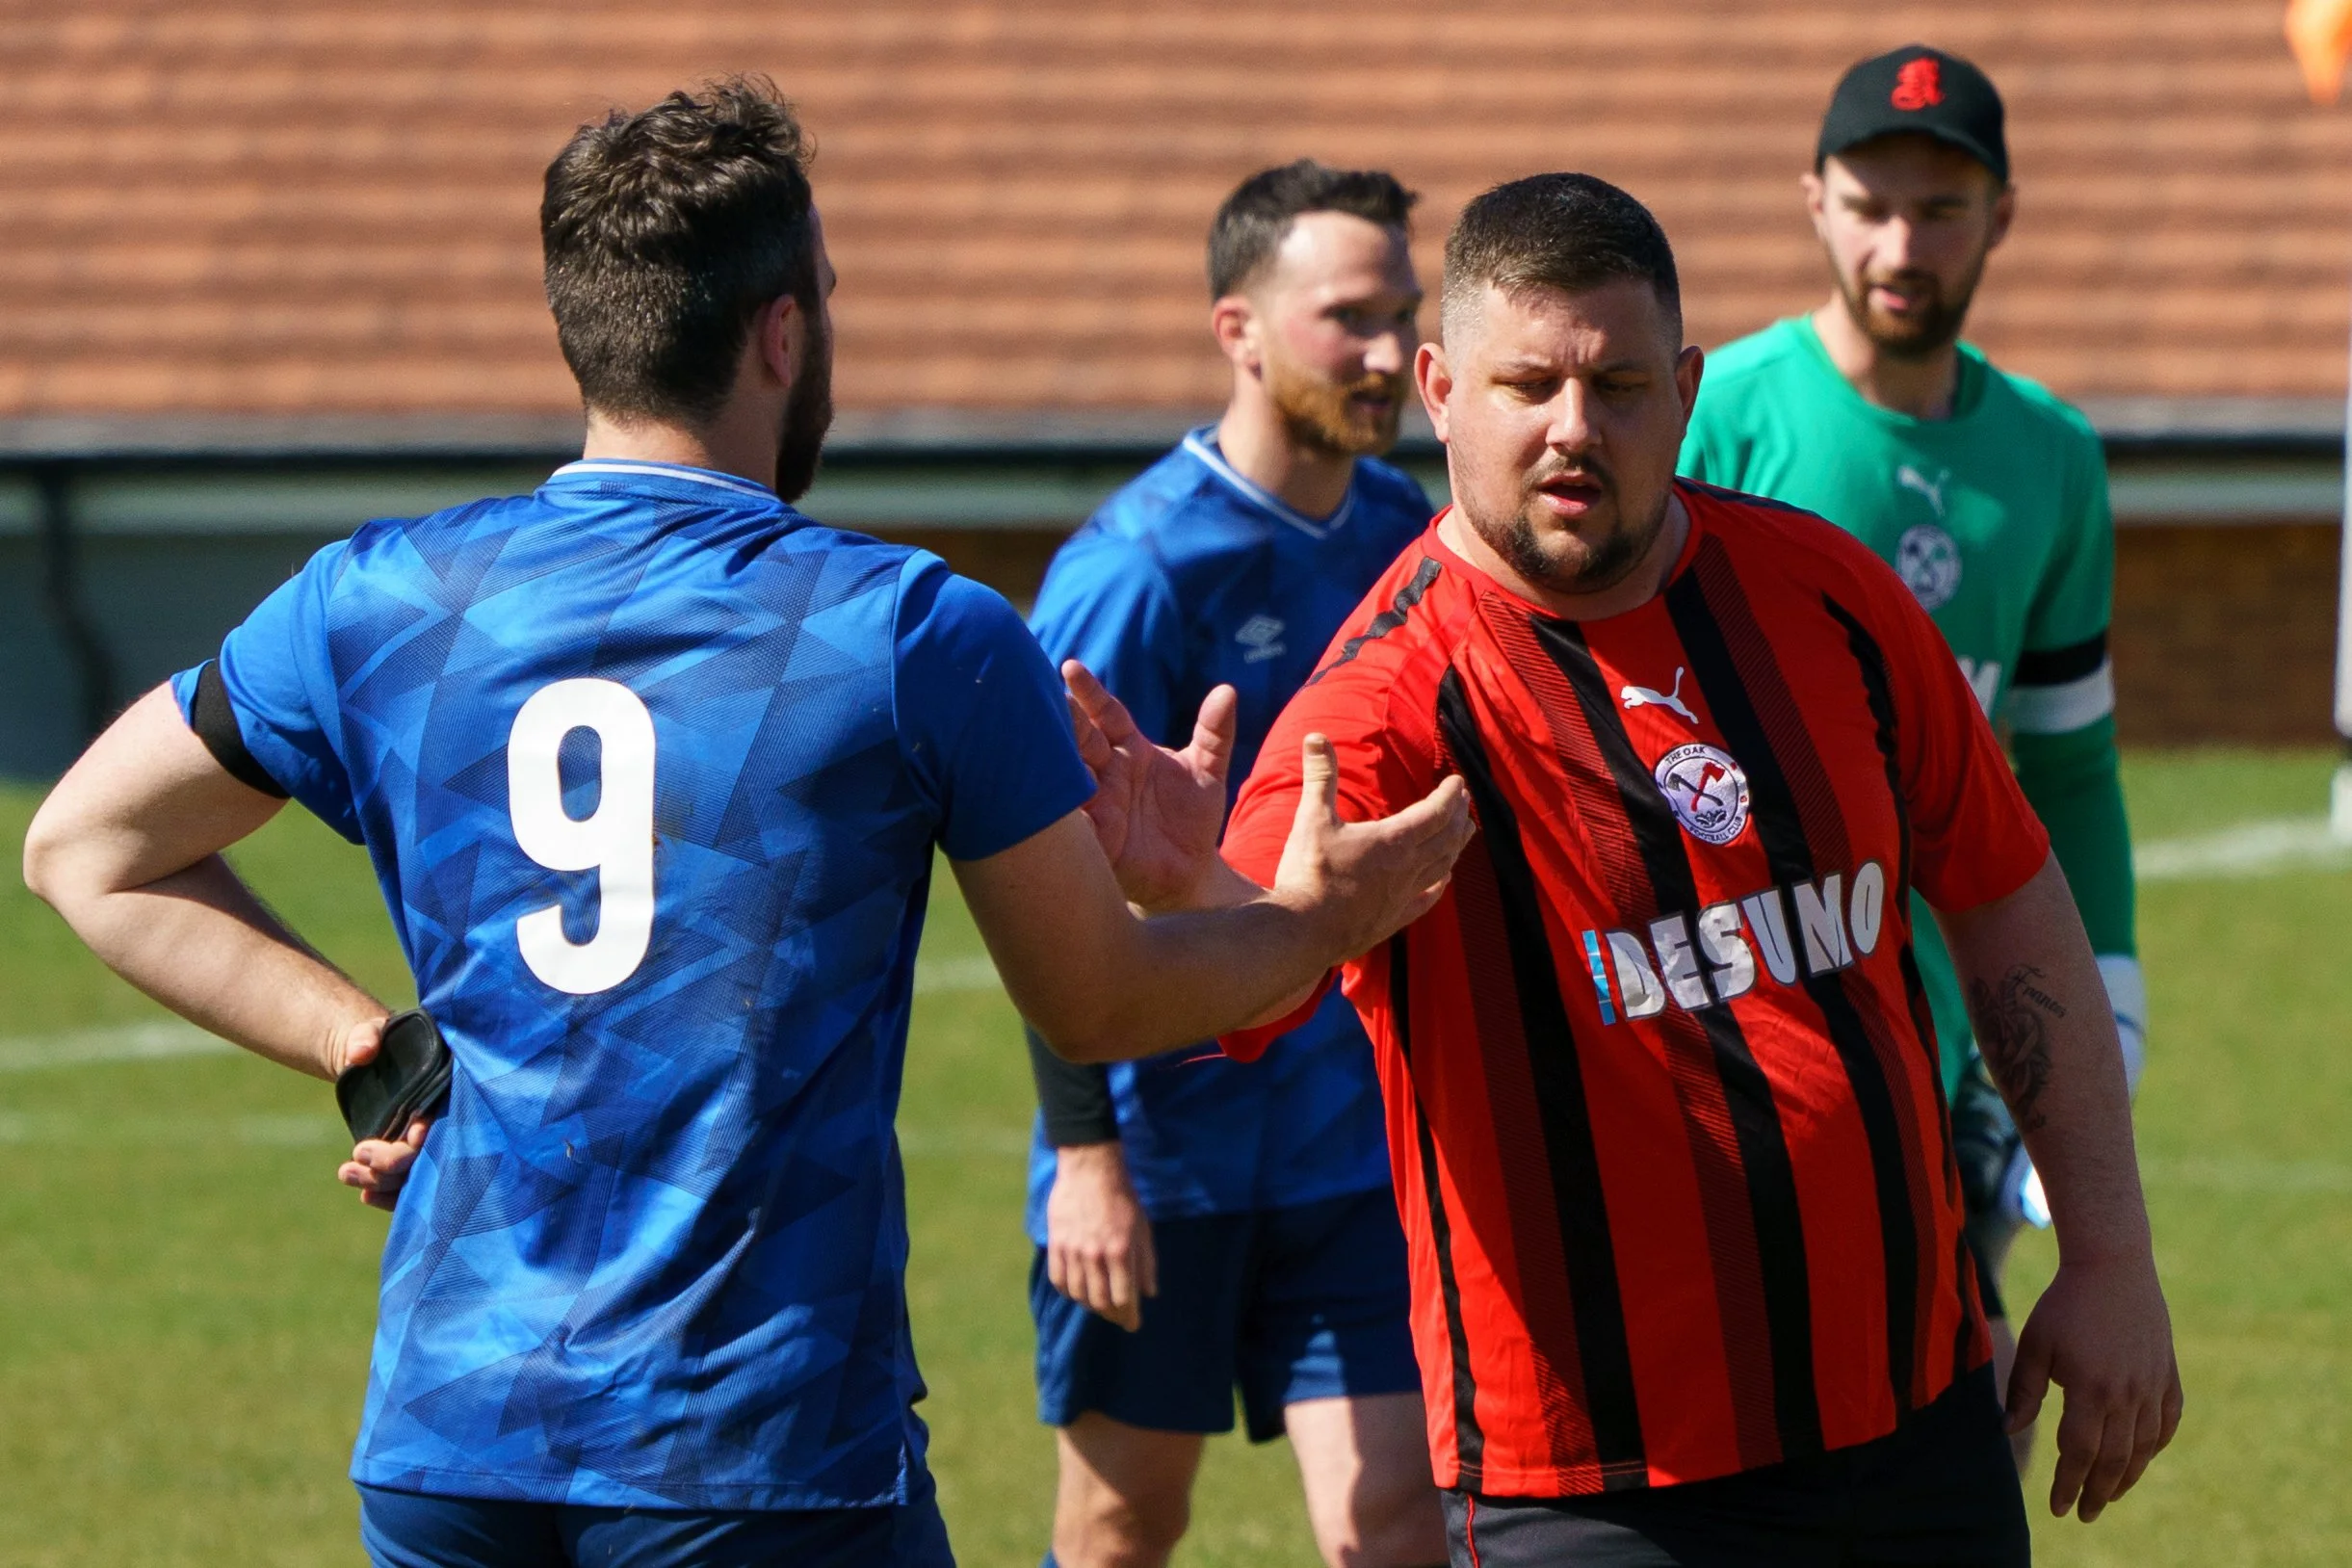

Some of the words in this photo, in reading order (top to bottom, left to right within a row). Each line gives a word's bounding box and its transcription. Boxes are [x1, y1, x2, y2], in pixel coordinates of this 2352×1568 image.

[1664, 751, 1683, 766] THE
[1684, 745, 1706, 757] OAK
[508, 677, 656, 995] 9
[1728, 816, 1743, 836] CLUB
